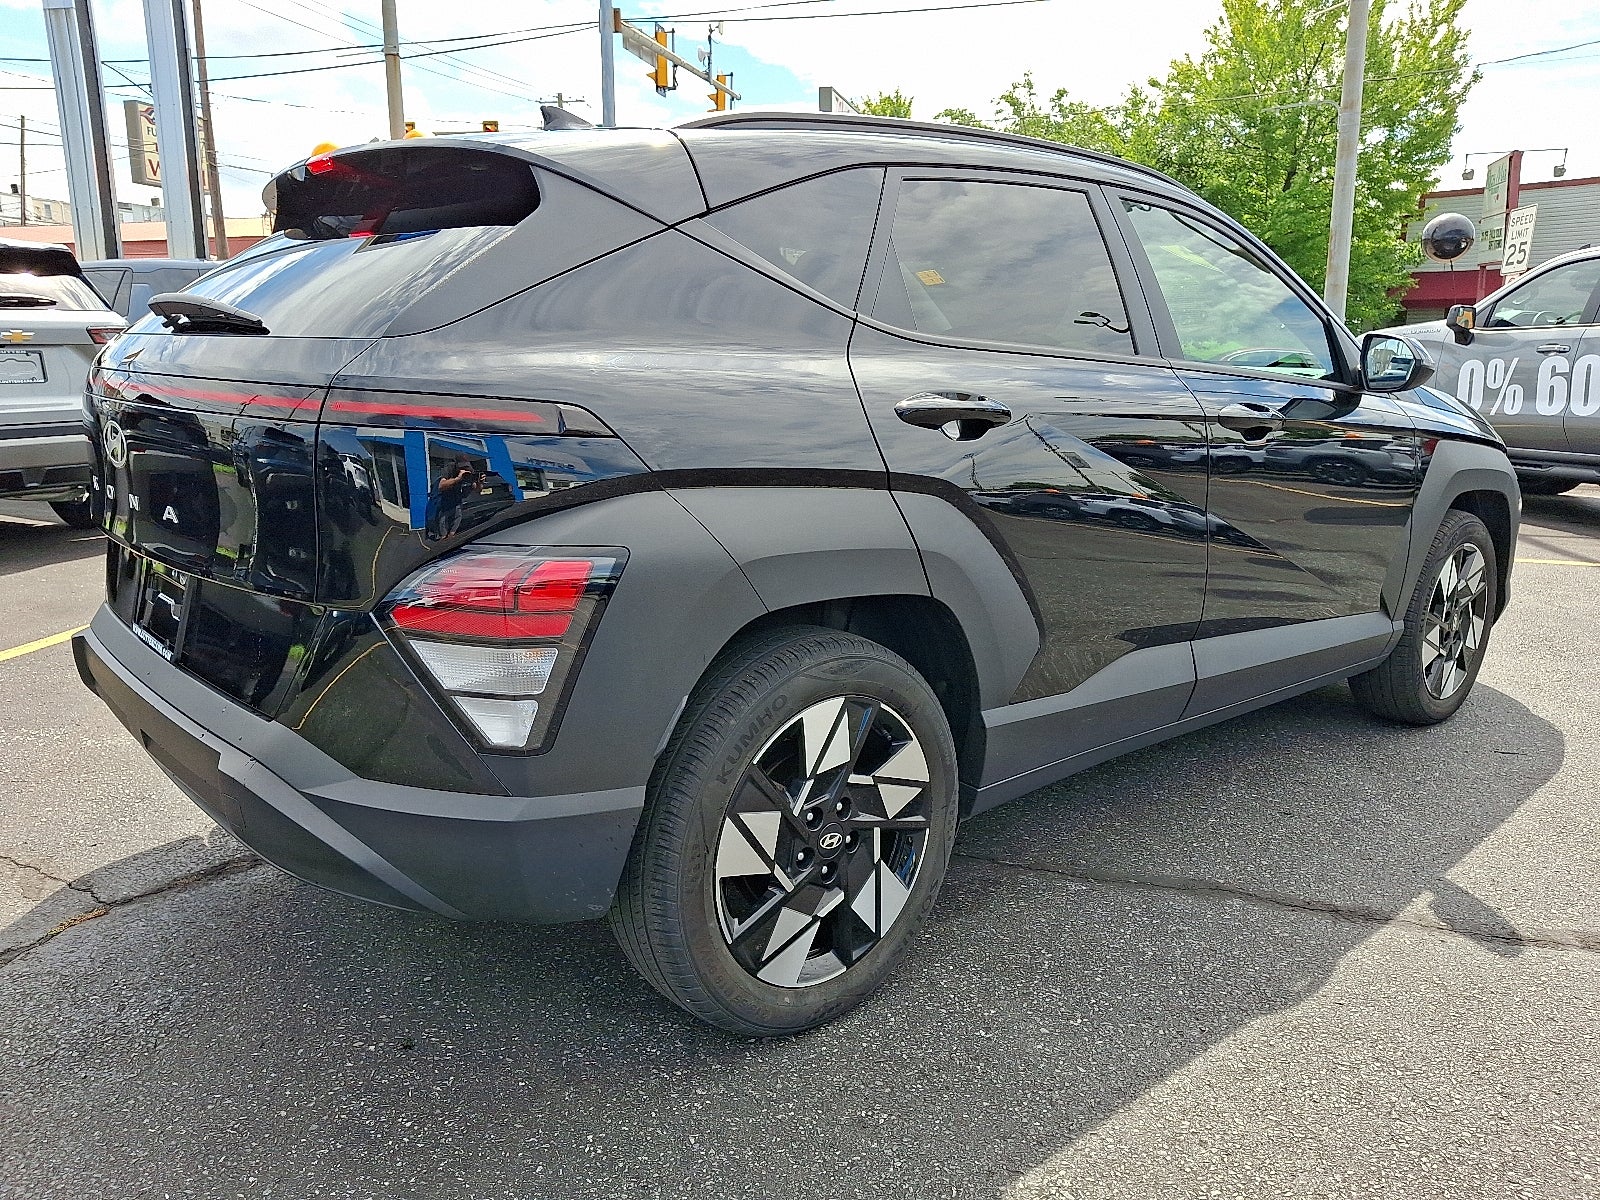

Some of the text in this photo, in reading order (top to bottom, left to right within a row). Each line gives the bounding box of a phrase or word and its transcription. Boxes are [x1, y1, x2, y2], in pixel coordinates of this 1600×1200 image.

[1510, 213, 1534, 228] SPEED
[1511, 227, 1530, 241] LIMIT
[1505, 240, 1528, 267] 25
[1456, 355, 1600, 417] 0% 60
[92, 475, 179, 524] KONA
[716, 694, 788, 785] KUMHO
